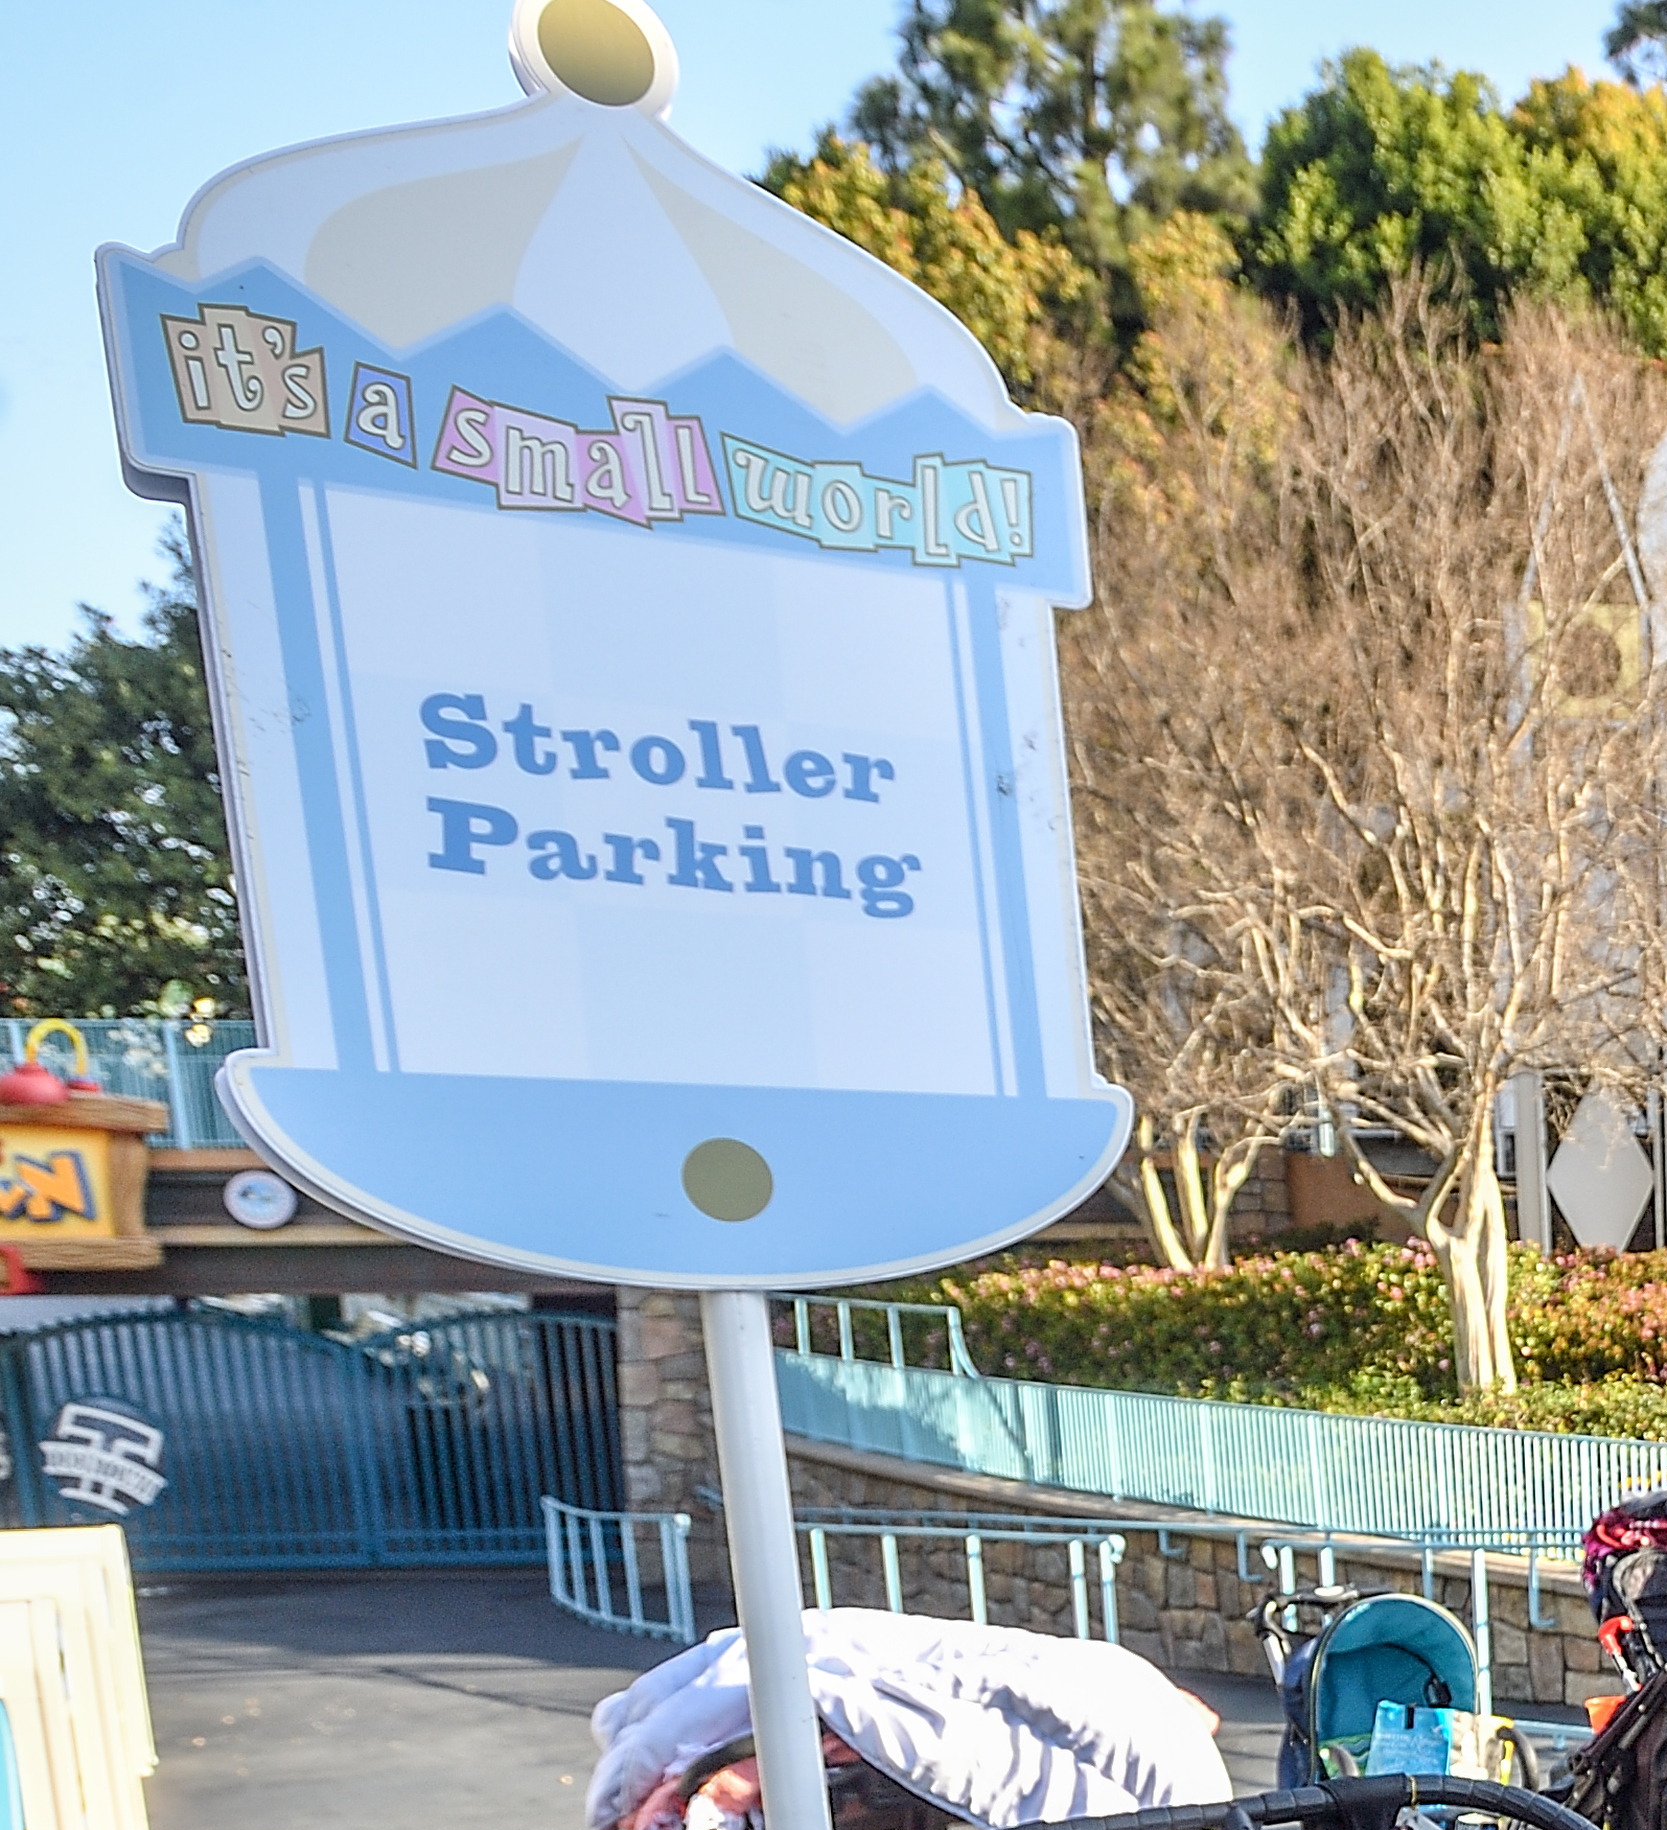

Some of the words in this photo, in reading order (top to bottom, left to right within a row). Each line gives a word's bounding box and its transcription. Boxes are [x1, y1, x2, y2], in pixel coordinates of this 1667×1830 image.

[177, 323, 317, 418] it's
[356, 380, 406, 451] a
[448, 406, 712, 513] small
[731, 447, 1023, 557] world!
[419, 691, 896, 804] Stroller
[426, 796, 923, 919] Parking
